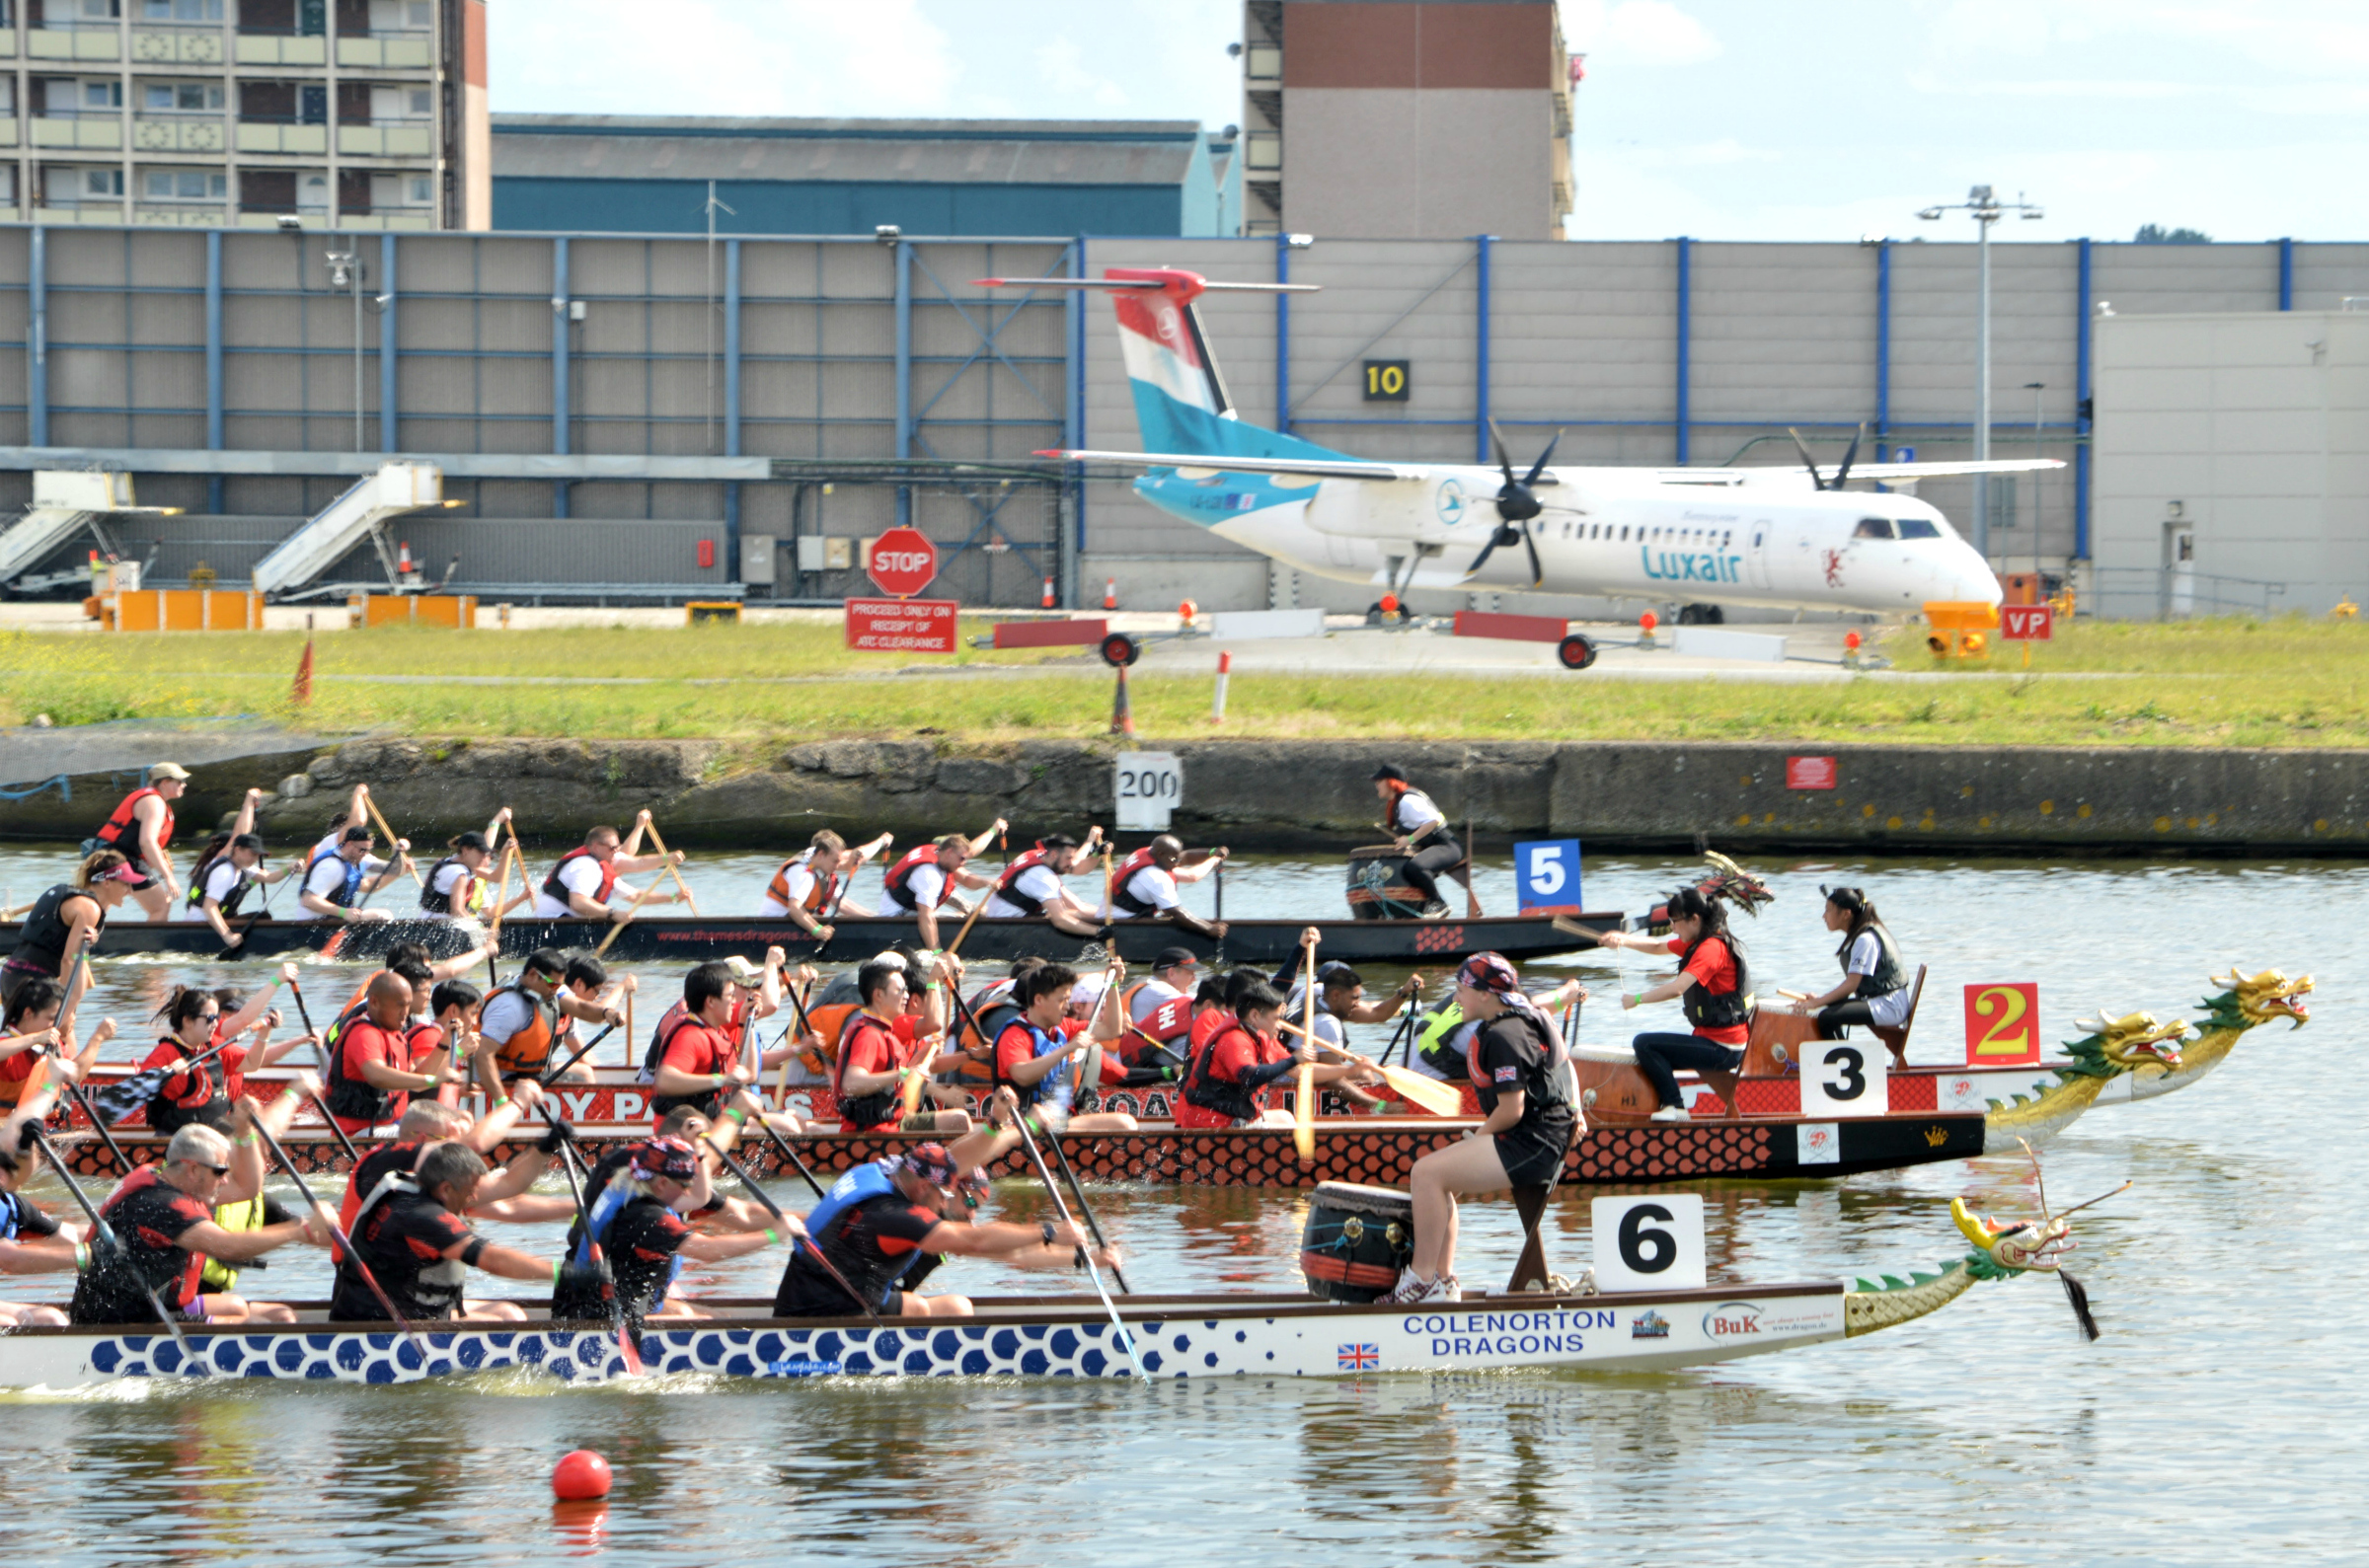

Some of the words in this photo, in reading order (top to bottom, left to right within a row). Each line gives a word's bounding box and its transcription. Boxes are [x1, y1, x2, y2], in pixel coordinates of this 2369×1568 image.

[1367, 366, 1404, 394] 10
[875, 552, 931, 572] STOP
[1641, 546, 1741, 582] Luxair
[2009, 613, 2046, 634] VP
[1119, 771, 1178, 797] 200
[1529, 846, 1566, 895] 5
[1975, 987, 2028, 1056] 2
[1822, 1046, 1867, 1101] 3
[1618, 1203, 1677, 1275] 6
[1404, 1310, 1615, 1333] COLENORTON
[1714, 1314, 1761, 1335] BuK
[1432, 1334, 1584, 1356] DRAGONS
